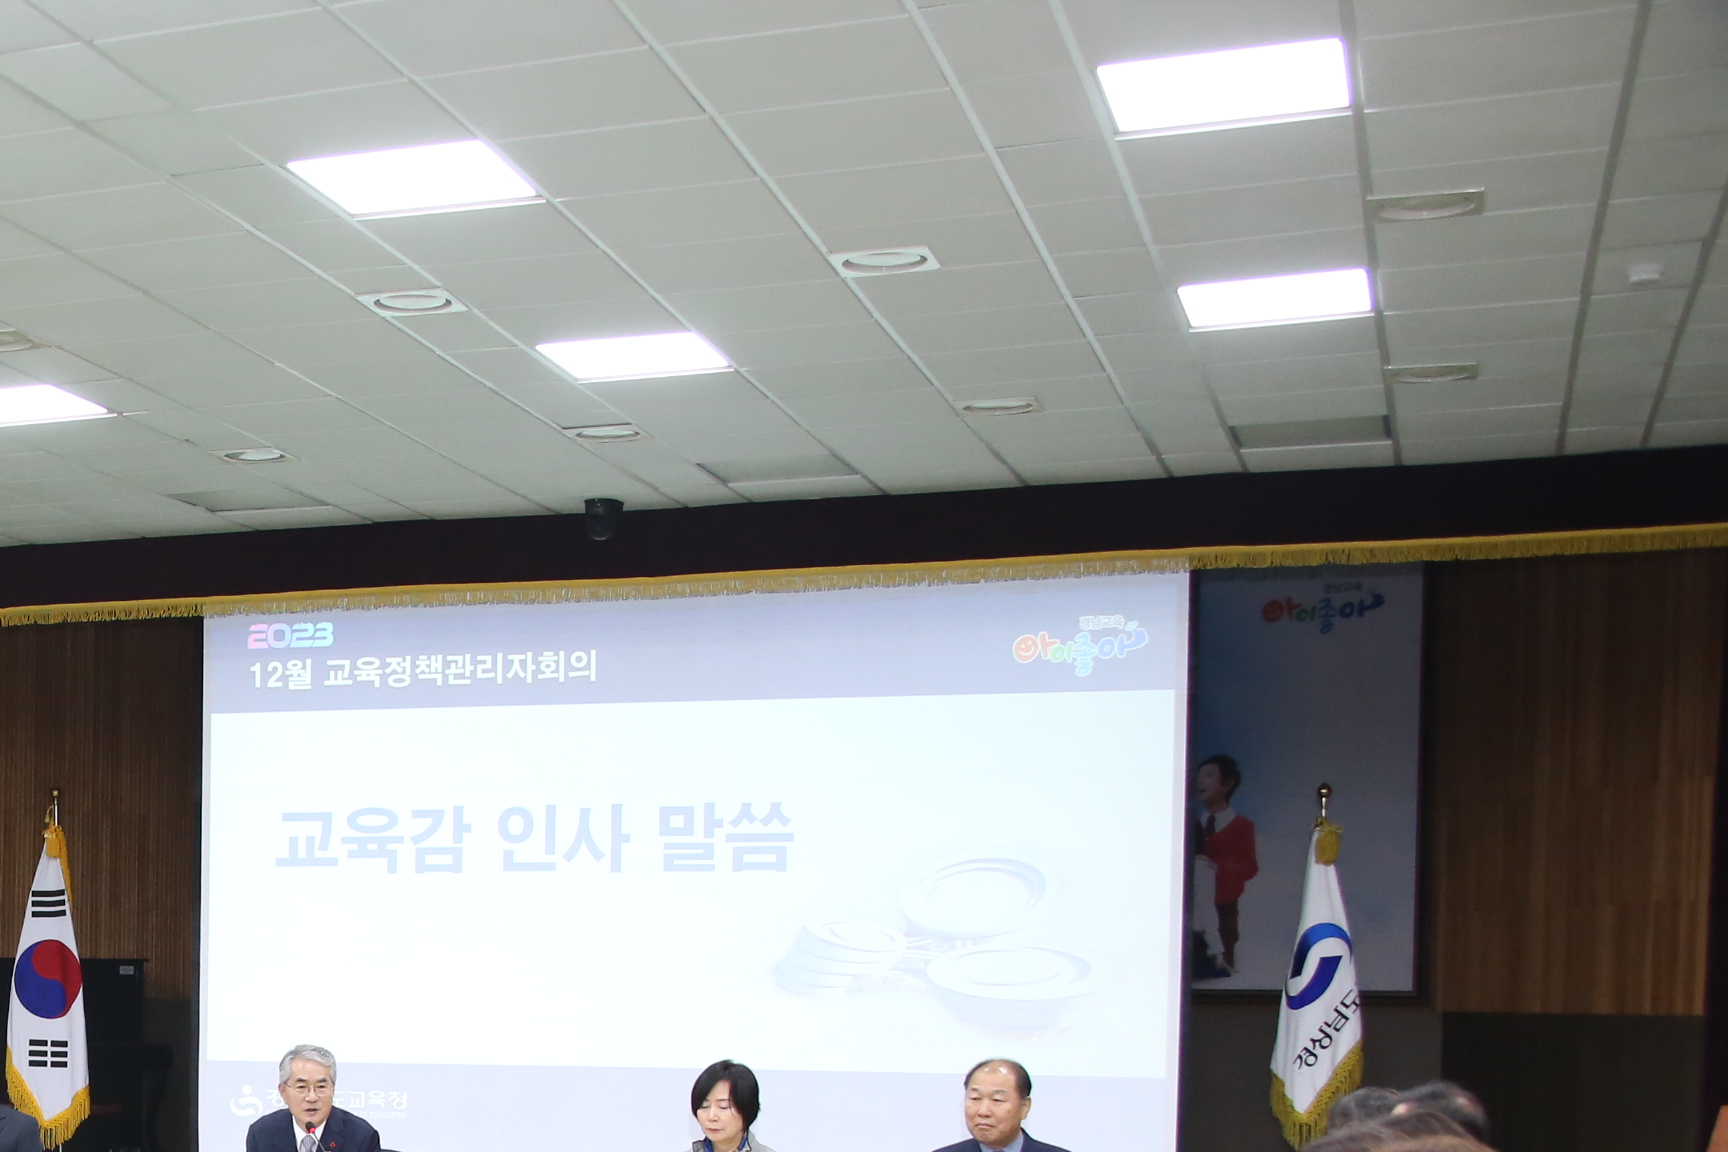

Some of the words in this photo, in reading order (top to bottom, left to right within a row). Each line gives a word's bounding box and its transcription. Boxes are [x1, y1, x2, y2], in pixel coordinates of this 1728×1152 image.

[1079, 615, 1124, 630] 경남교육
[1261, 596, 1385, 634] 아이좋아
[247, 621, 334, 649] 2023
[1012, 630, 1148, 677] 아이좋아
[249, 658, 313, 690] 12월
[323, 649, 598, 688] 교육정책관리자회의
[275, 805, 472, 875] 교육감
[497, 803, 630, 873] 인사
[659, 801, 795, 873] 말씀
[1292, 988, 1360, 1070] 경상남도
[266, 1089, 408, 1110] 경도교육청
